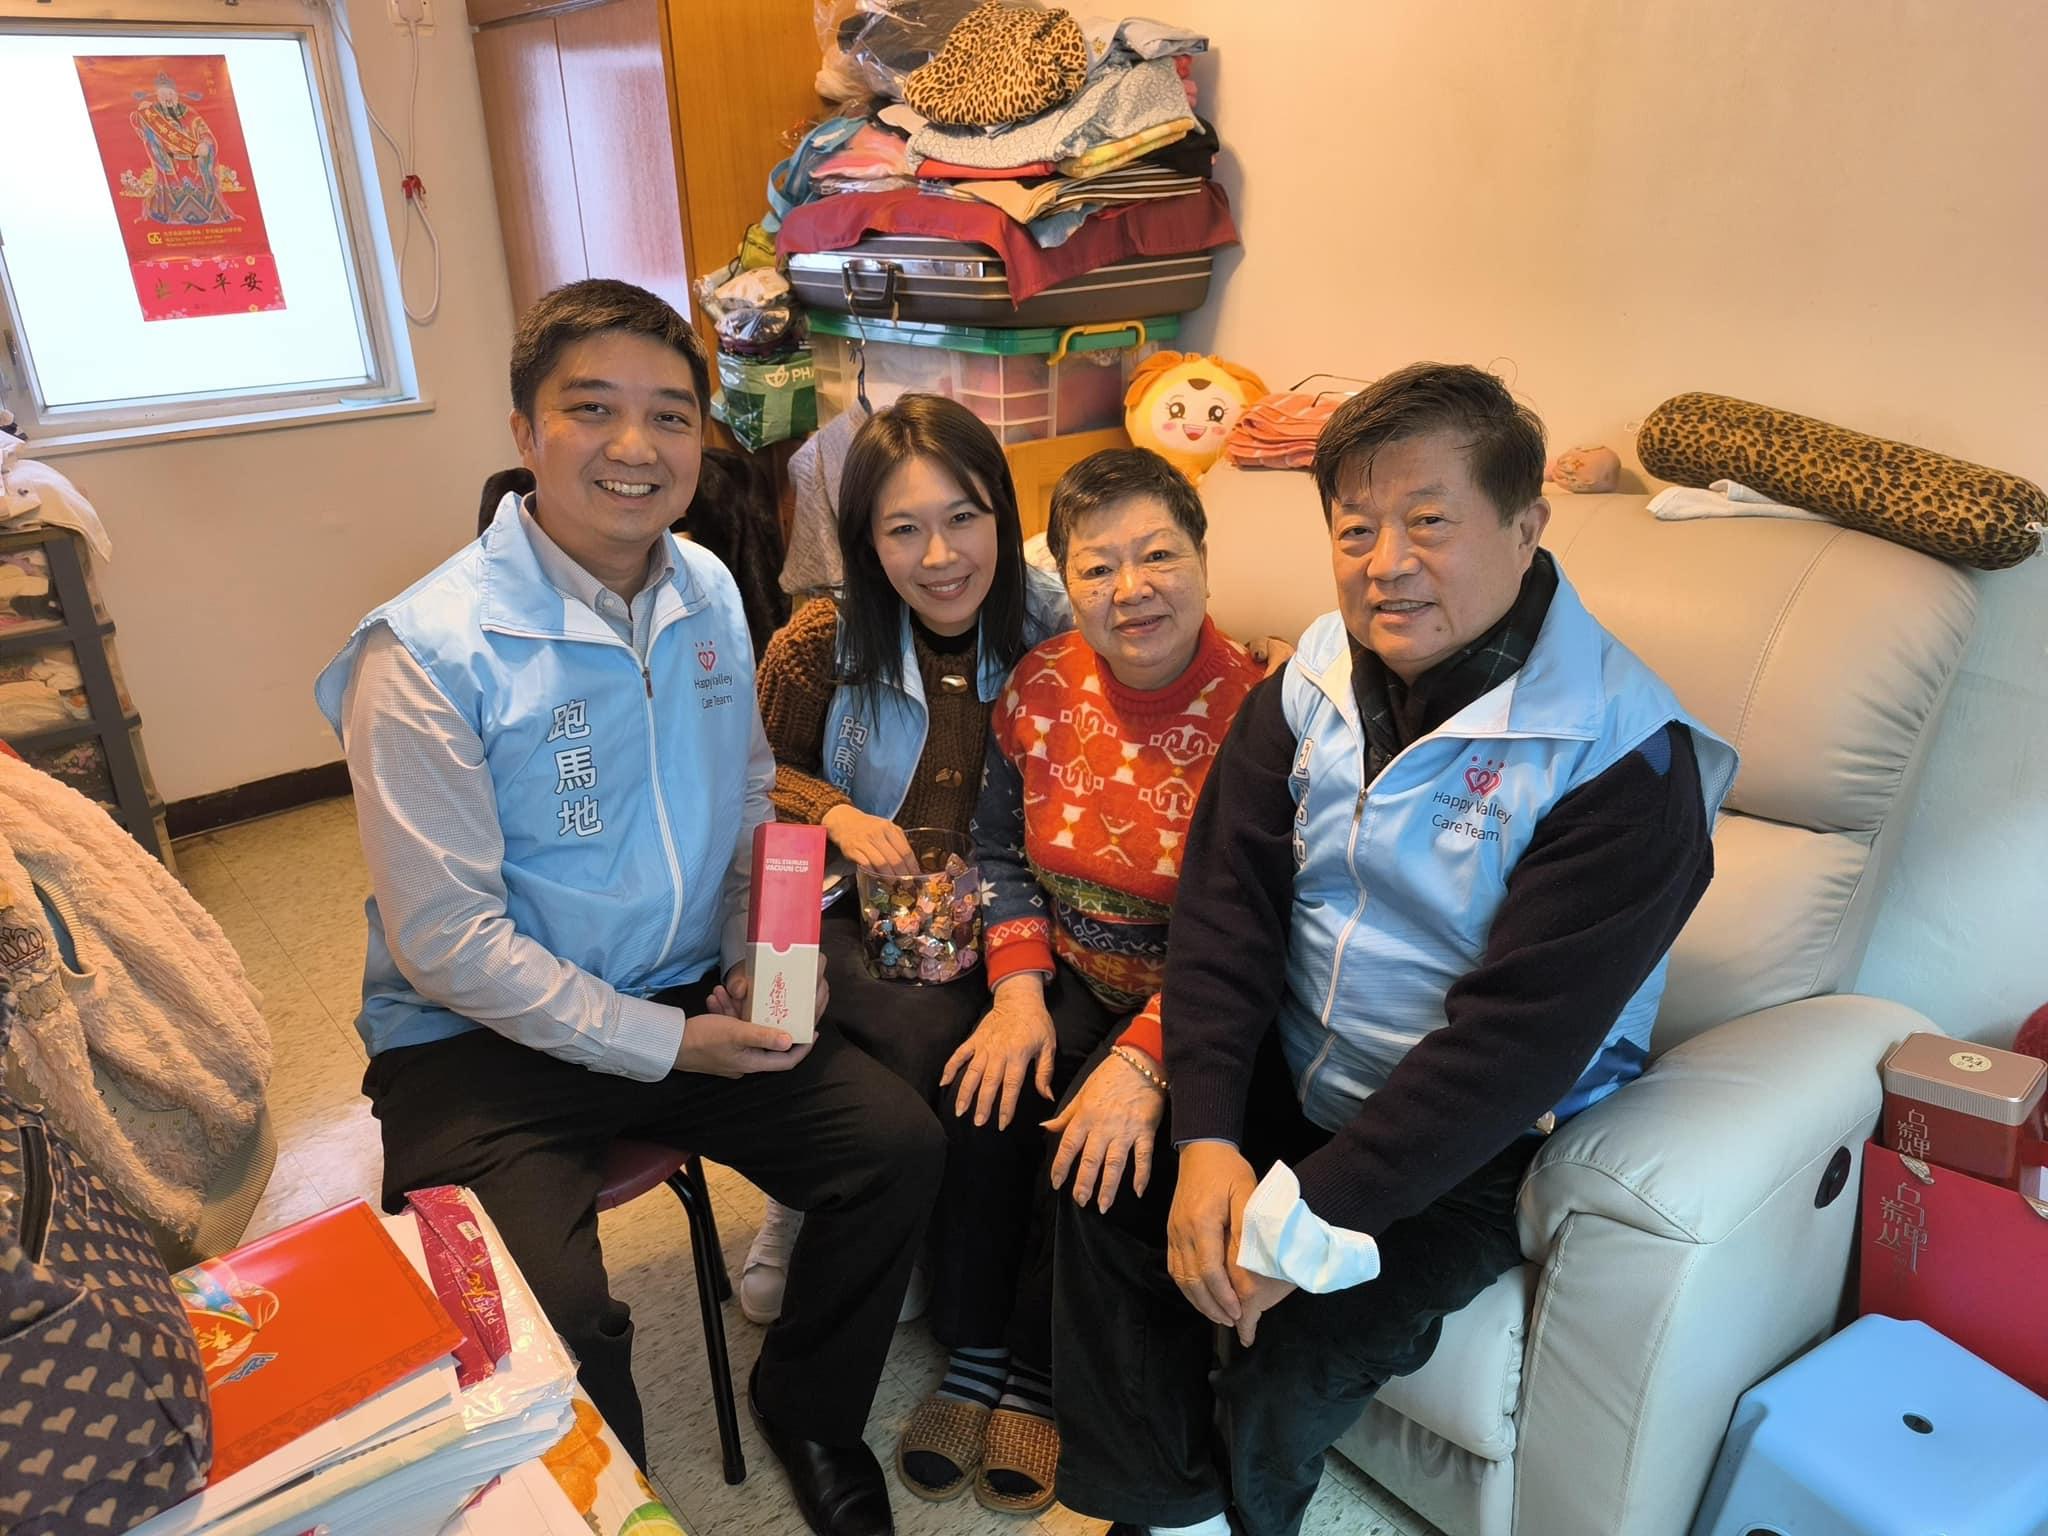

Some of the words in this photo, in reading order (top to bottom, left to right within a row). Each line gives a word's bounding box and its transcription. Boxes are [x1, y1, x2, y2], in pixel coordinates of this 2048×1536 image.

[546, 699, 603, 837] 跑馬地
[1432, 791, 1474, 814] Happy
[1475, 799, 1512, 825] Valley
[1431, 814, 1463, 833] Care
[1464, 822, 1501, 842] Team
